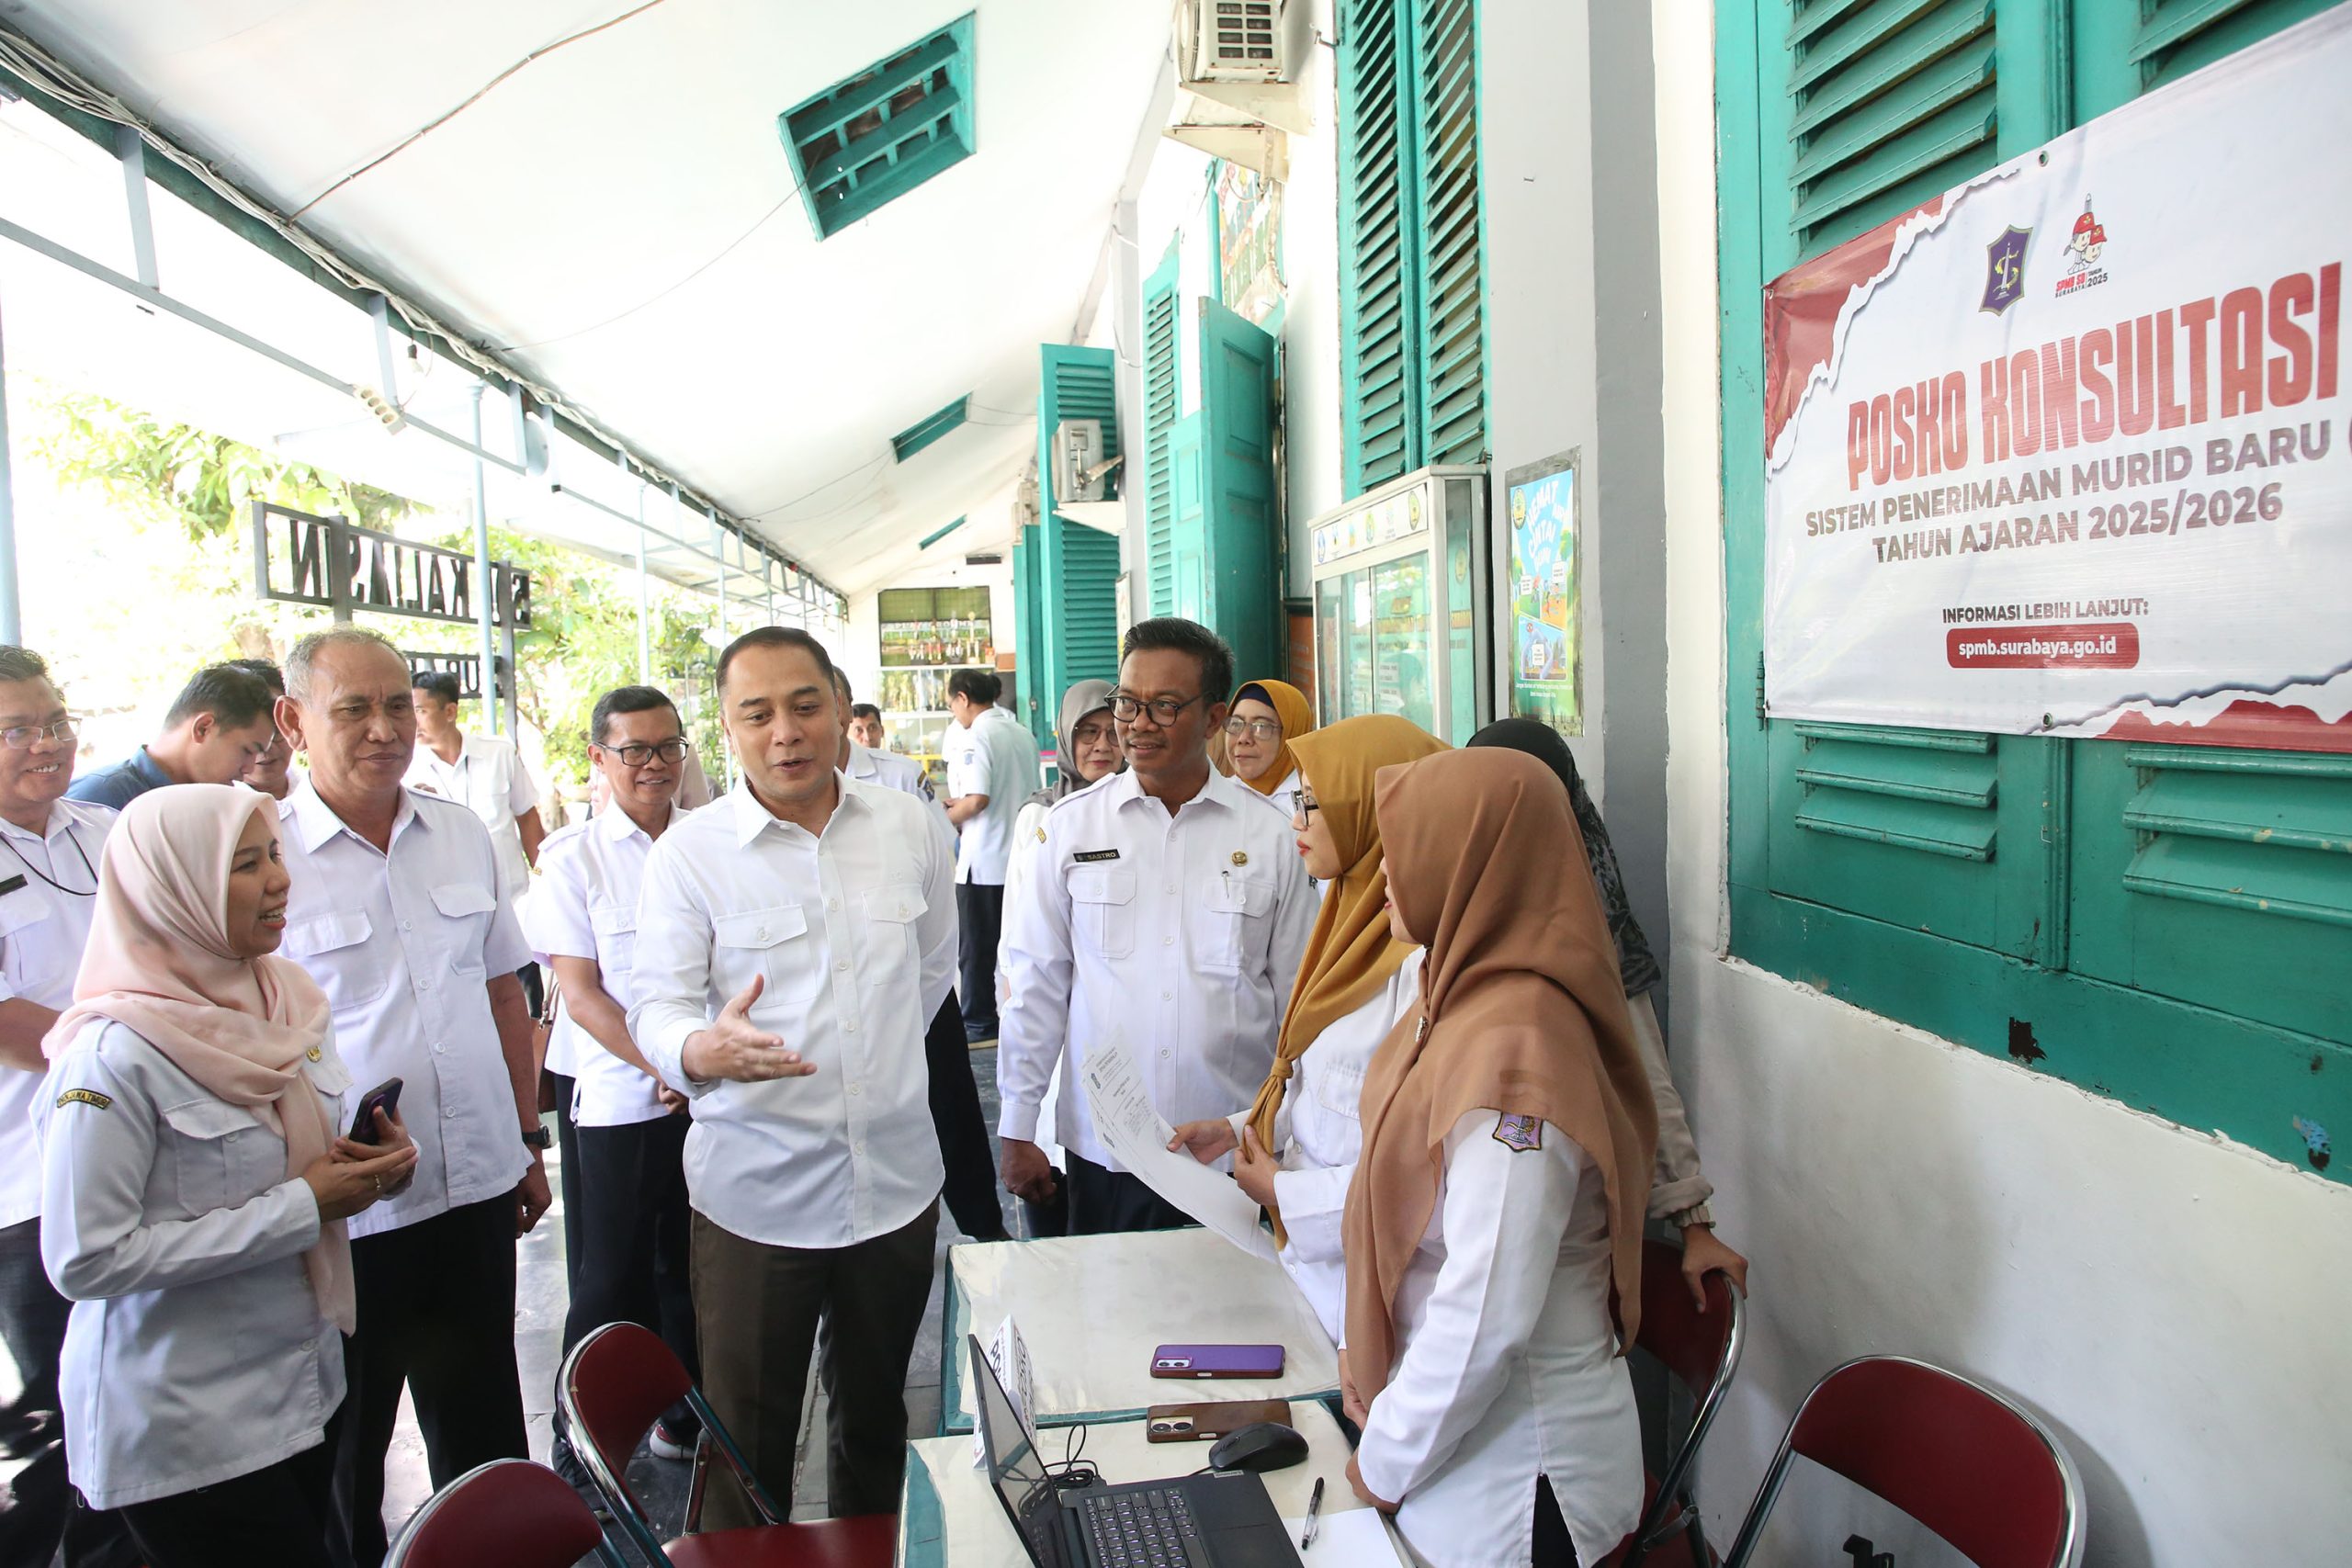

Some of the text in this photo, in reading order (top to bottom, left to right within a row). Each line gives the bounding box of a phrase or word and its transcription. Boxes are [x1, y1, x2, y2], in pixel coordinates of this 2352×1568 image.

[2055, 285, 2085, 298] SURABAYA
[2087, 273, 2108, 288] 2025
[1847, 261, 2342, 491] POSKO KONSULTASI
[1805, 501, 1876, 536] SISTEM
[1883, 467, 2062, 525] PENERIMAAN
[2072, 446, 2193, 496] MURID
[2206, 419, 2331, 476] BARU
[1872, 481, 2283, 563] TAHUN AJARAN 2025/2026
[1942, 597, 2149, 624] INFORMASI LEBIH LANJUT:
[1958, 635, 2117, 660] spmb.surabaya.go.id
